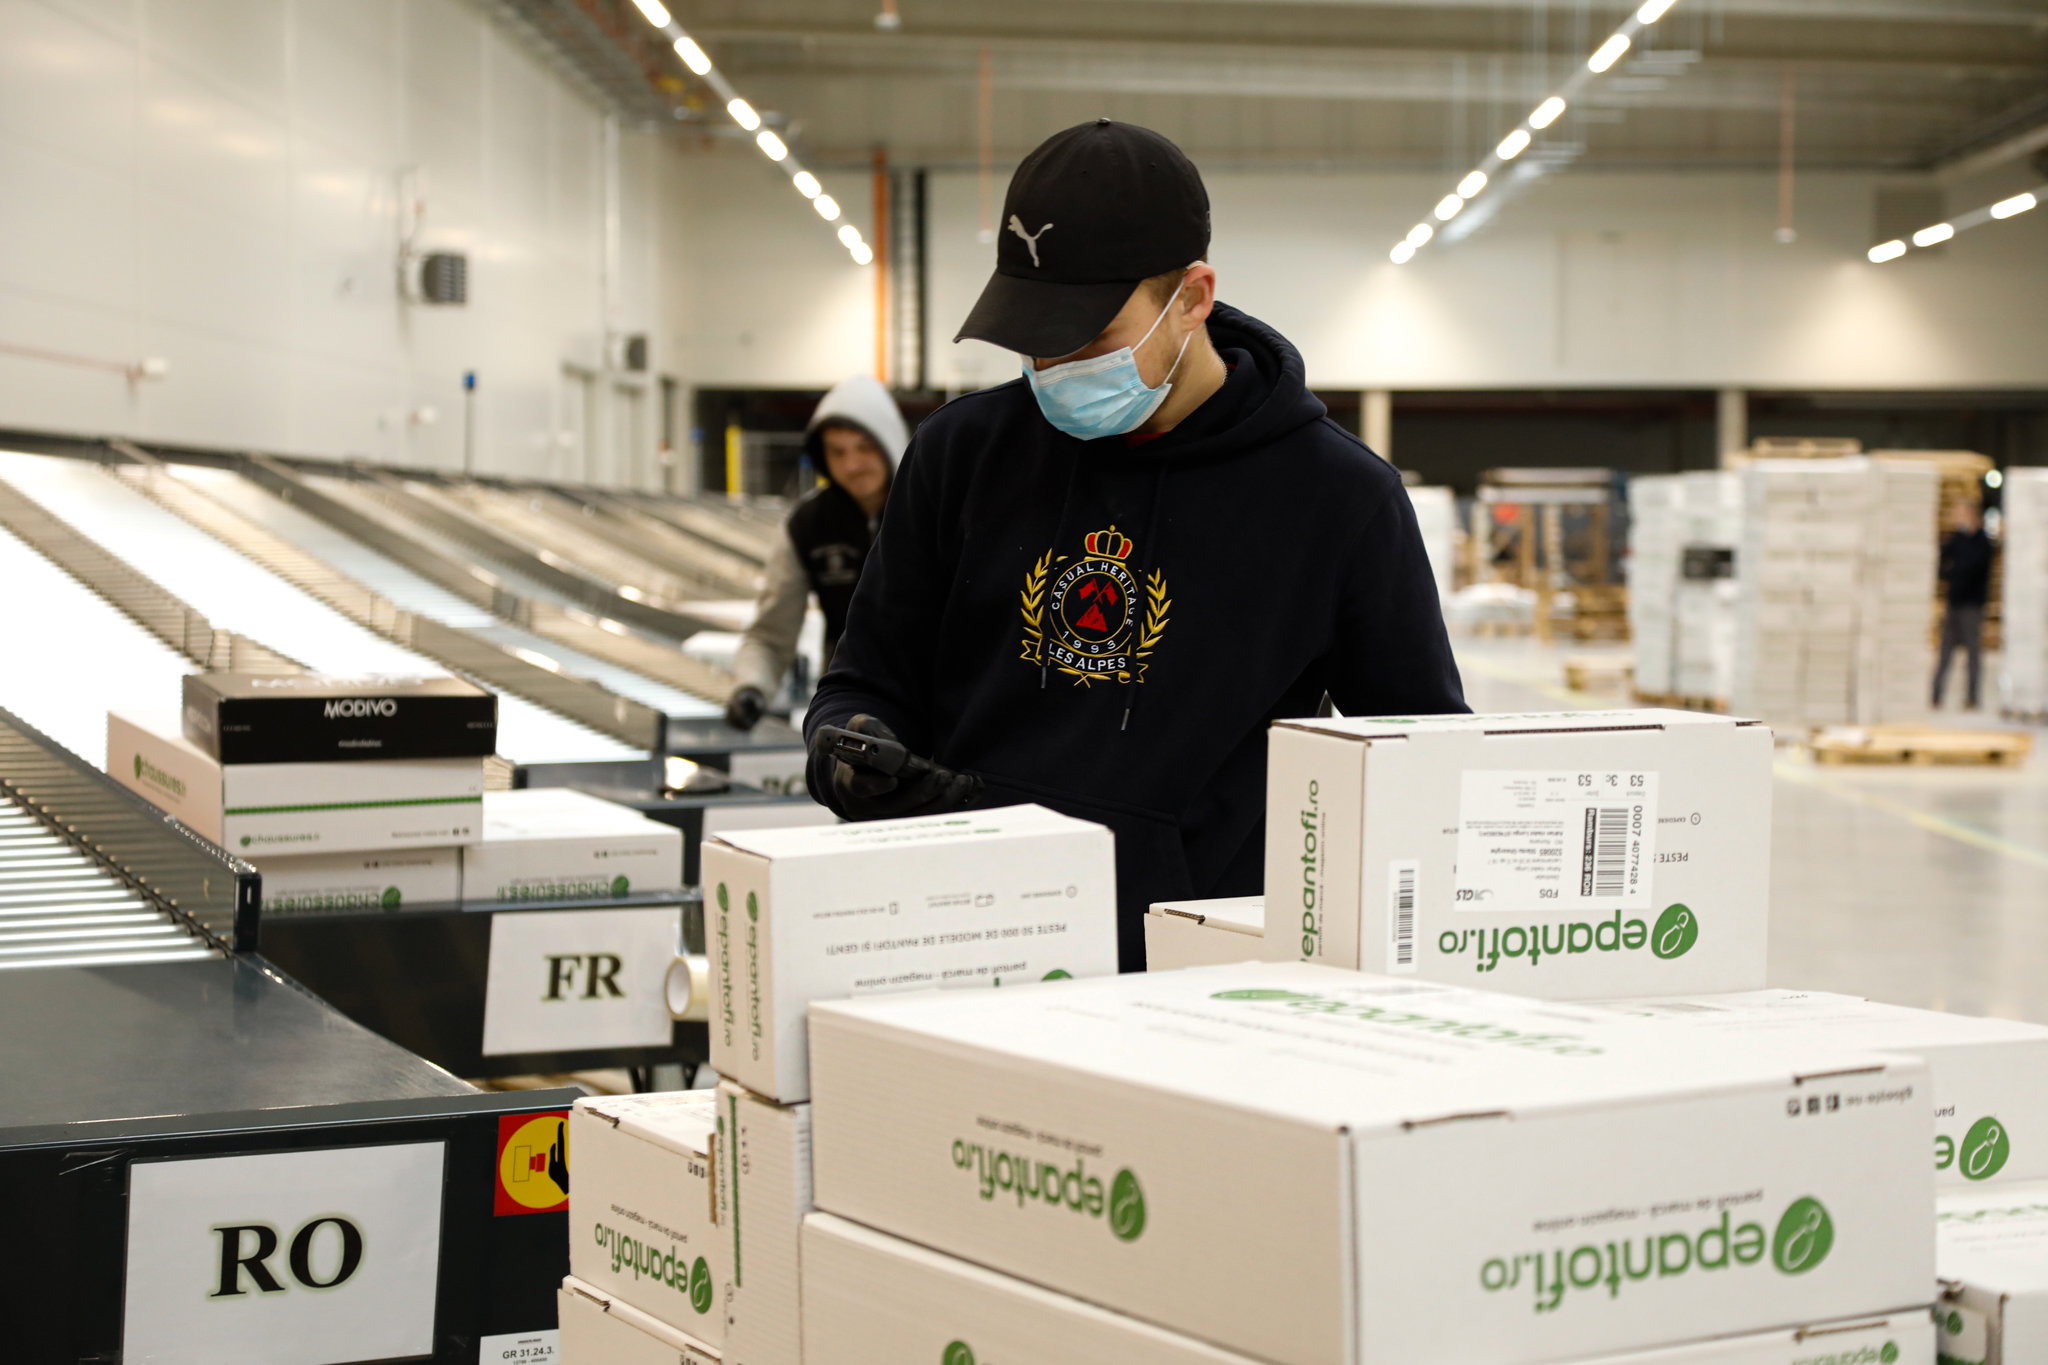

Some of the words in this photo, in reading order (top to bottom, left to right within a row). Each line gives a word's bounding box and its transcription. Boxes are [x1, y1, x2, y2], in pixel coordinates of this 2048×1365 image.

[1051, 562, 1094, 610] CASUAL
[1102, 562, 1137, 626] HERITAGE
[1062, 631, 1116, 653] 1993
[1048, 643, 1073, 664] LES
[1075, 657, 1126, 671] ALPES
[323, 699, 397, 718] MODIVO
[1578, 774, 1592, 786] 53
[1630, 774, 1644, 786] 53
[1584, 808, 1597, 854] Ramburs:
[1632, 806, 1642, 837] 0007
[1630, 841, 1640, 885] 4077428
[1659, 853, 1689, 863] PESTE
[1301, 780, 1319, 957] epantofi.ro
[1456, 889, 1474, 900] GLS
[1539, 889, 1559, 899] FDS
[1581, 874, 1592, 896] RON
[985, 930, 998, 940] DE
[1021, 927, 1033, 936] 50
[1037, 923, 1067, 933] PESTE
[873, 938, 918, 951] PANTOFI
[922, 936, 935, 947] DE
[939, 932, 982, 945] MODELE
[1438, 909, 1648, 972] epantofi.ro
[540, 953, 626, 1002] FR
[888, 972, 932, 983] magazin
[976, 967, 987, 976] de
[992, 961, 1027, 975] pantofi
[718, 915, 736, 1047] epantofi.ro
[854, 977, 885, 989] online
[747, 925, 763, 1061] epantofi.ro
[952, 1139, 1105, 1220] epantofi.ro
[209, 1217, 363, 1298] RO
[594, 1223, 688, 1294] epantofi.ro
[1480, 1211, 1767, 1313] epantofi.ro
[502, 1350, 517, 1359] GR
